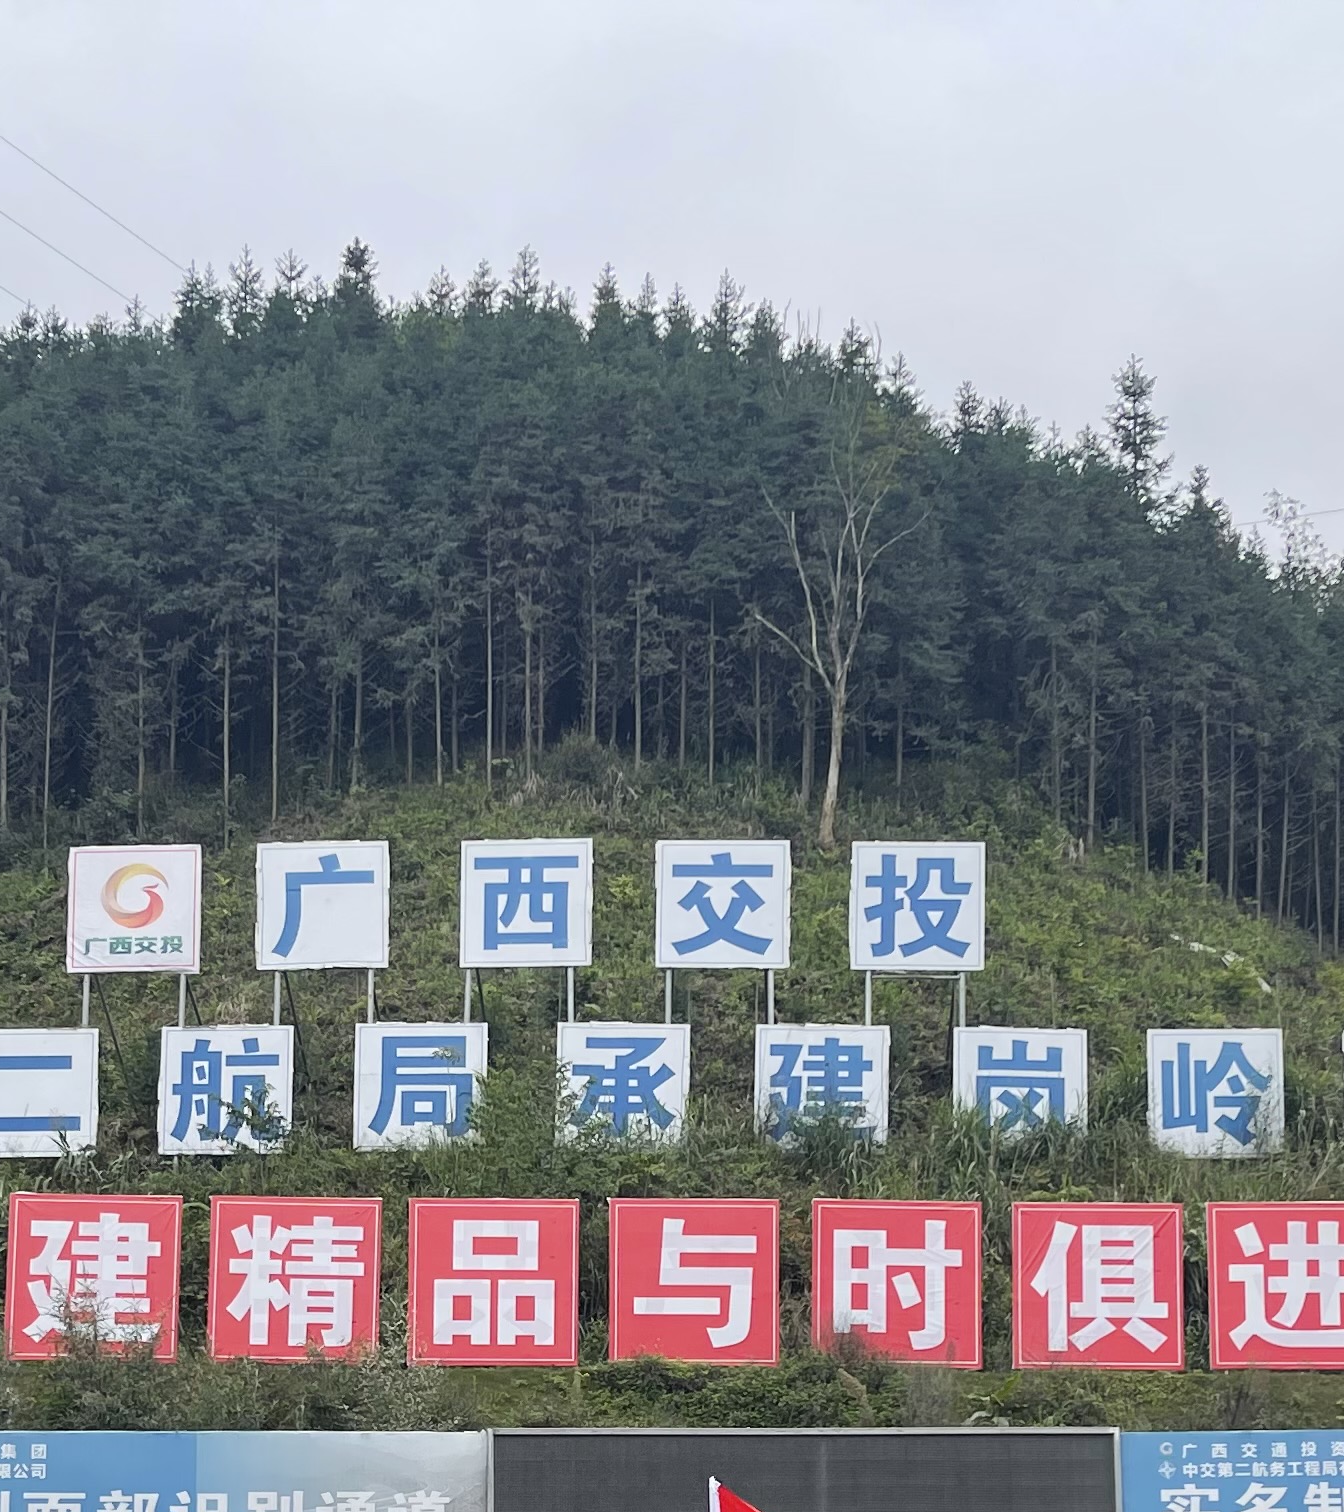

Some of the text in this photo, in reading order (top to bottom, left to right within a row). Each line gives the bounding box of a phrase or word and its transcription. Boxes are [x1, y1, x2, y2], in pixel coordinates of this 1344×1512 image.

[274, 852, 972, 959] 广西交投
[83, 935, 183, 956] 广西交投
